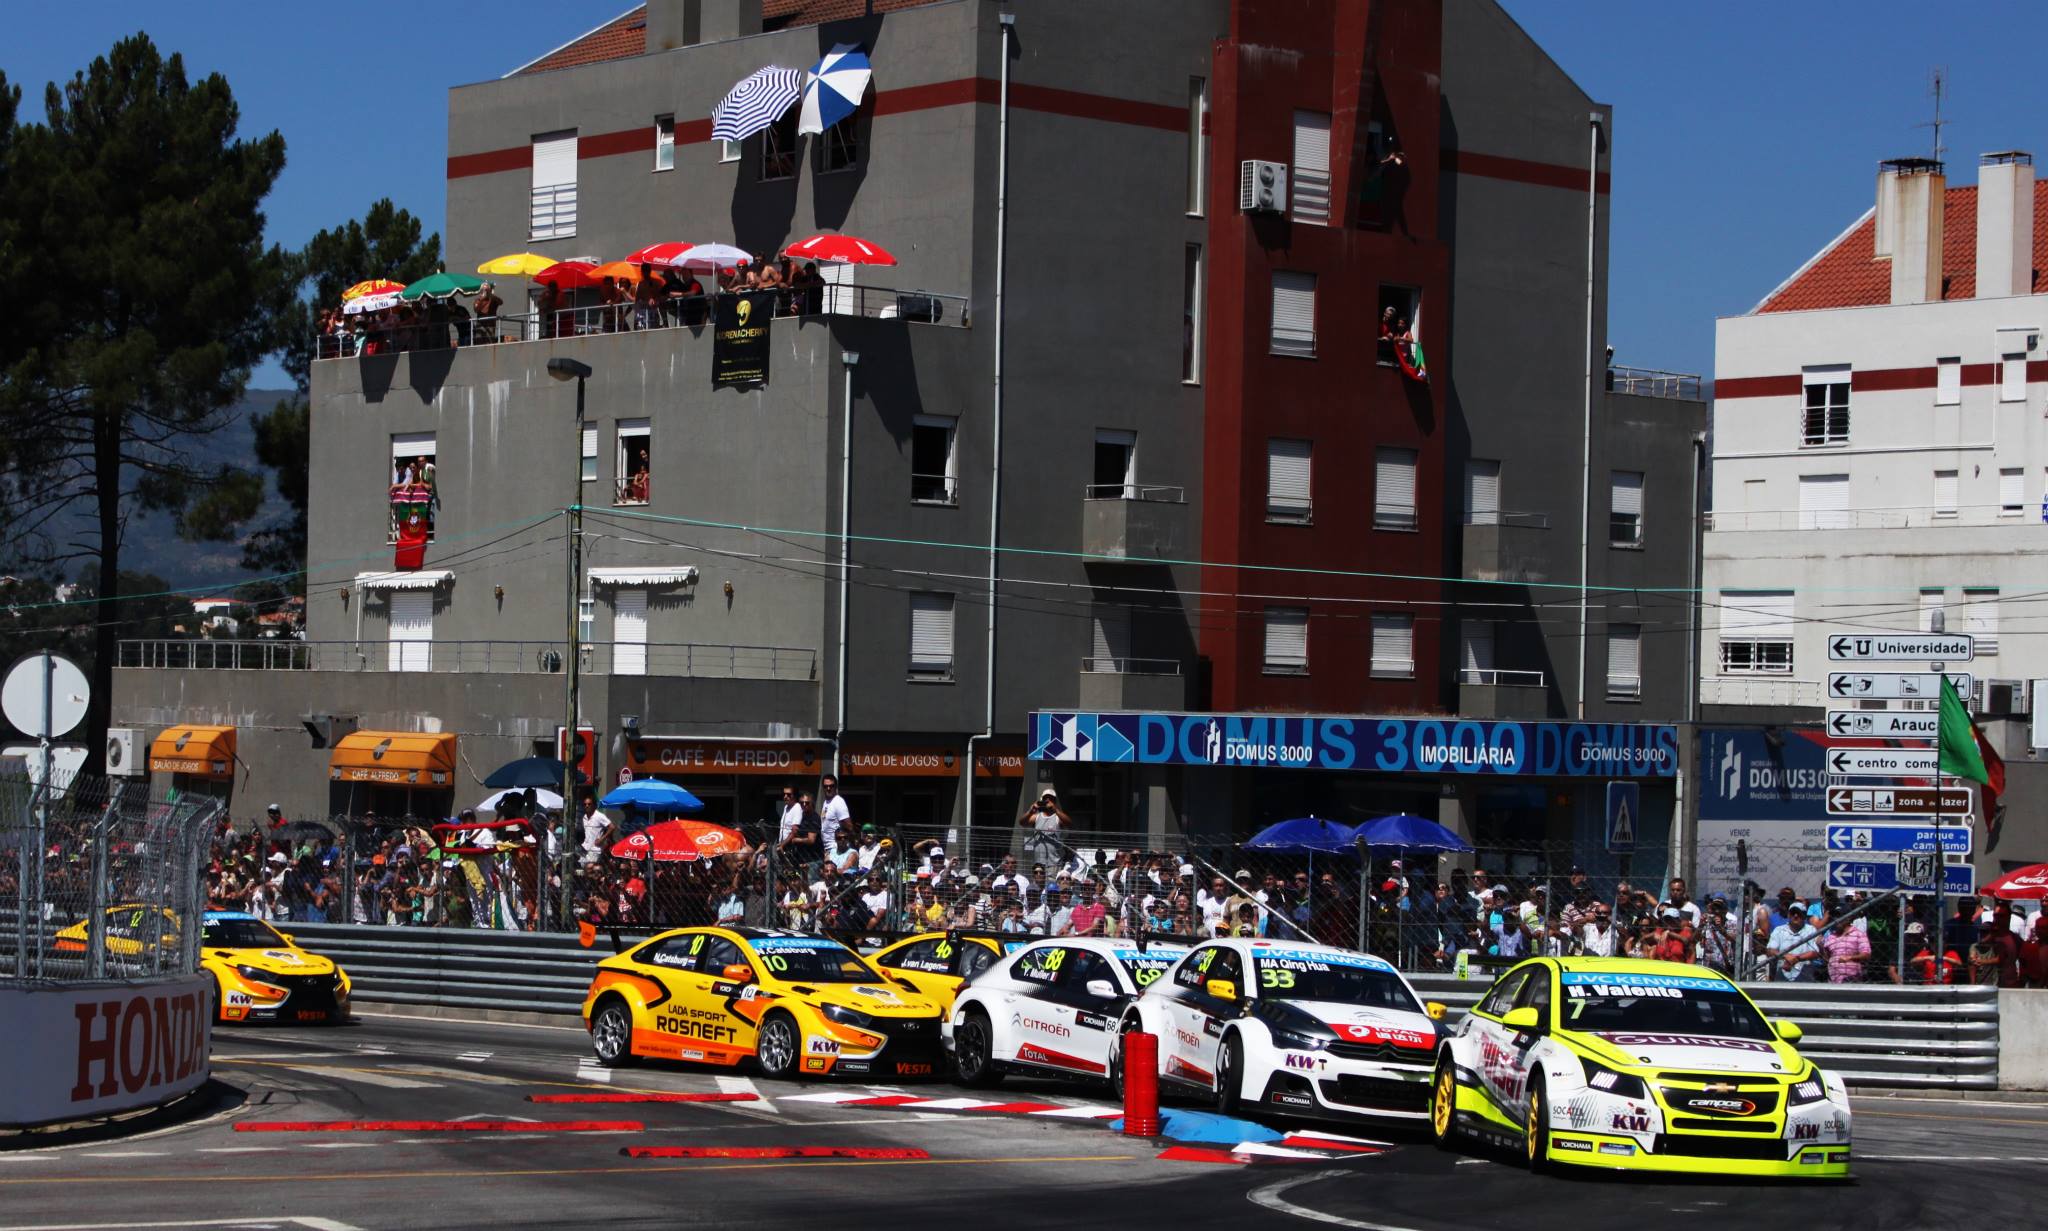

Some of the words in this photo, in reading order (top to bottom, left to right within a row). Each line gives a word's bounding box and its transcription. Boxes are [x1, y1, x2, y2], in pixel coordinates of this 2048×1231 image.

[1877, 642, 1968, 654] Universidade
[1890, 718, 1938, 731] Arauc
[1138, 715, 1356, 769] DOMUS
[1375, 719, 1526, 776] 3000
[1226, 744, 1277, 761] DOMUS
[1280, 745, 1313, 762] 3000
[660, 746, 705, 766] CAFÉ
[713, 750, 790, 767] ALFREDO
[842, 751, 880, 767] SALÃO
[883, 754, 897, 767] DE
[900, 754, 939, 767] JOGOS
[978, 756, 1022, 767] ENTRADA
[1420, 743, 1515, 765] IMOBILIÁRIA
[1581, 747, 1632, 761] DOMUS
[1634, 748, 1666, 762] 3000
[1857, 758, 1898, 769] centro
[1905, 759, 1938, 769] come
[1899, 798, 1924, 807] zona
[1941, 798, 1967, 807] lazer
[1729, 829, 1751, 838] VENDE
[1802, 829, 1826, 837] ARREND
[689, 935, 705, 955] 10
[935, 940, 952, 959] 40
[762, 955, 787, 972] 10
[1046, 949, 1066, 970] 68
[1261, 948, 1298, 957] JVC
[1299, 950, 1388, 970] KENWOOD
[1261, 959, 1277, 969] MA
[1280, 960, 1306, 973] Qing
[1308, 961, 1331, 972] Hua
[1136, 968, 1162, 986] 68
[1261, 969, 1296, 989] 33
[1571, 975, 1612, 983] JVC
[1615, 976, 1730, 990] KENWOOD
[230, 995, 252, 1004] KW
[1568, 985, 1592, 998] H.
[1593, 985, 1683, 999] Valente
[668, 1004, 688, 1016] LADA
[690, 1009, 727, 1023] SPORT
[1568, 998, 1586, 1020] 7
[657, 1016, 737, 1043] ROSNEFT
[1023, 1018, 1070, 1038] CITROËN
[1107, 1018, 1116, 1032] 68
[71, 989, 205, 1101] HONDA
[812, 1041, 840, 1053] KW
[1613, 1034, 1769, 1051] GUINOT
[896, 1062, 931, 1075] VESTA
[1285, 1054, 1316, 1070] KW
[1282, 1096, 1310, 1105] YOKOHAMA
[1688, 1098, 1743, 1108] campos
[1612, 1114, 1650, 1132] KW
[1795, 1124, 1820, 1139] KW
[1561, 1141, 1591, 1150] YOKOHAMA
